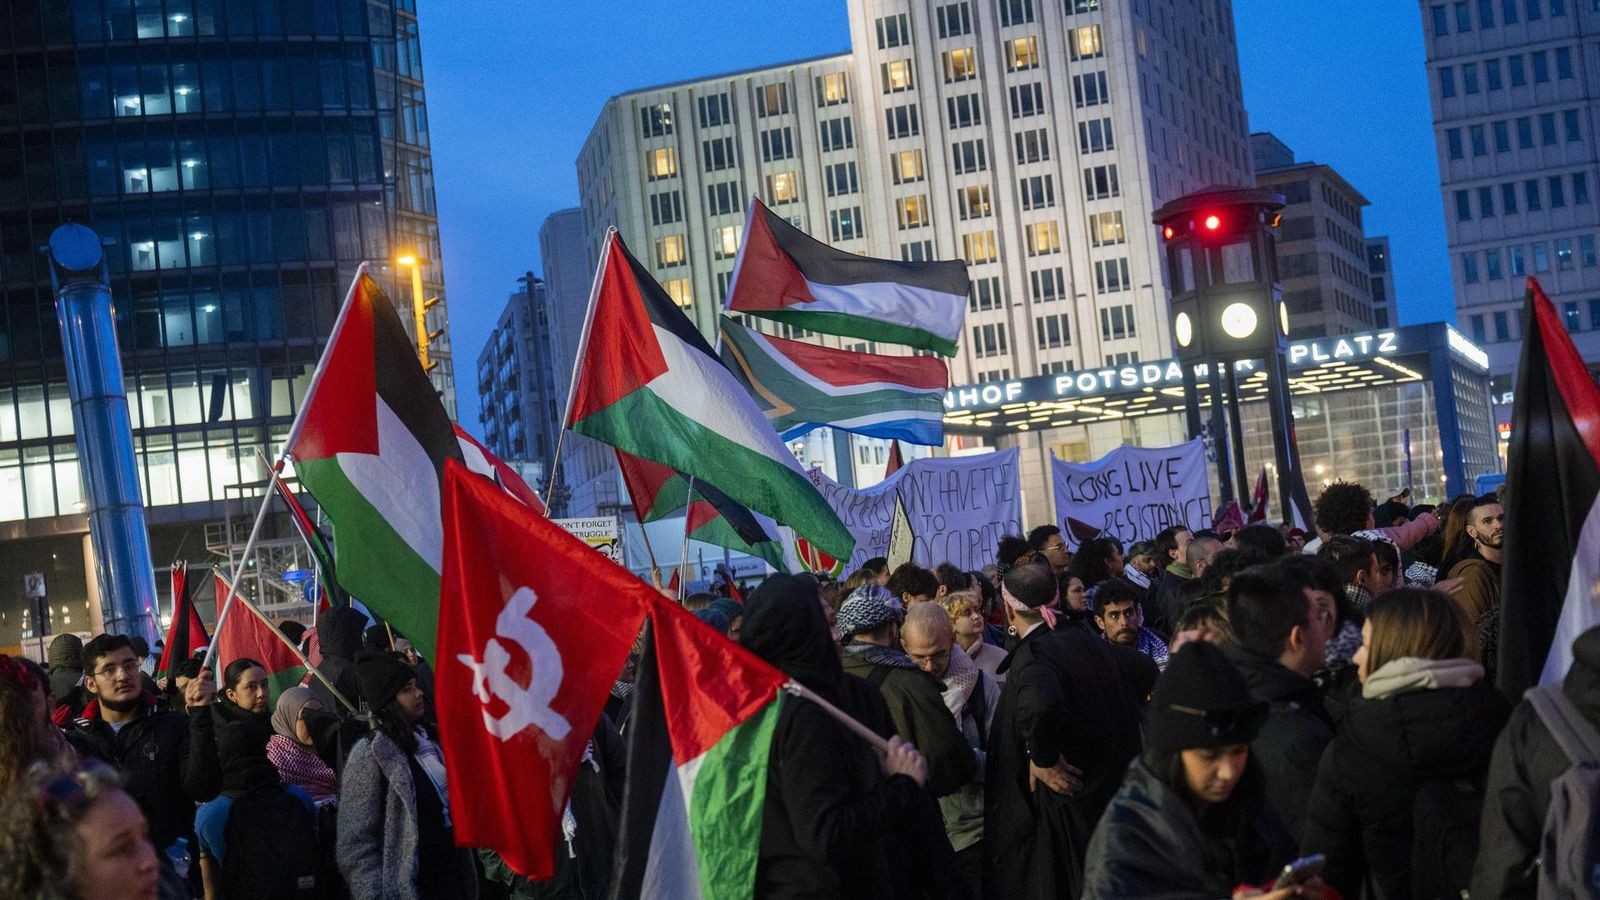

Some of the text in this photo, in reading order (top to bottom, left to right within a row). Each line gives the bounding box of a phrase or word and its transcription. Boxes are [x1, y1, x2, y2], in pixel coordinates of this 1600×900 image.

[943, 332, 1397, 408] NHOF POTSDAMR PLATZ
[1066, 456, 1182, 503] LONG LIVE
[581, 520, 612, 529] FORGET
[921, 513, 946, 533] TO
